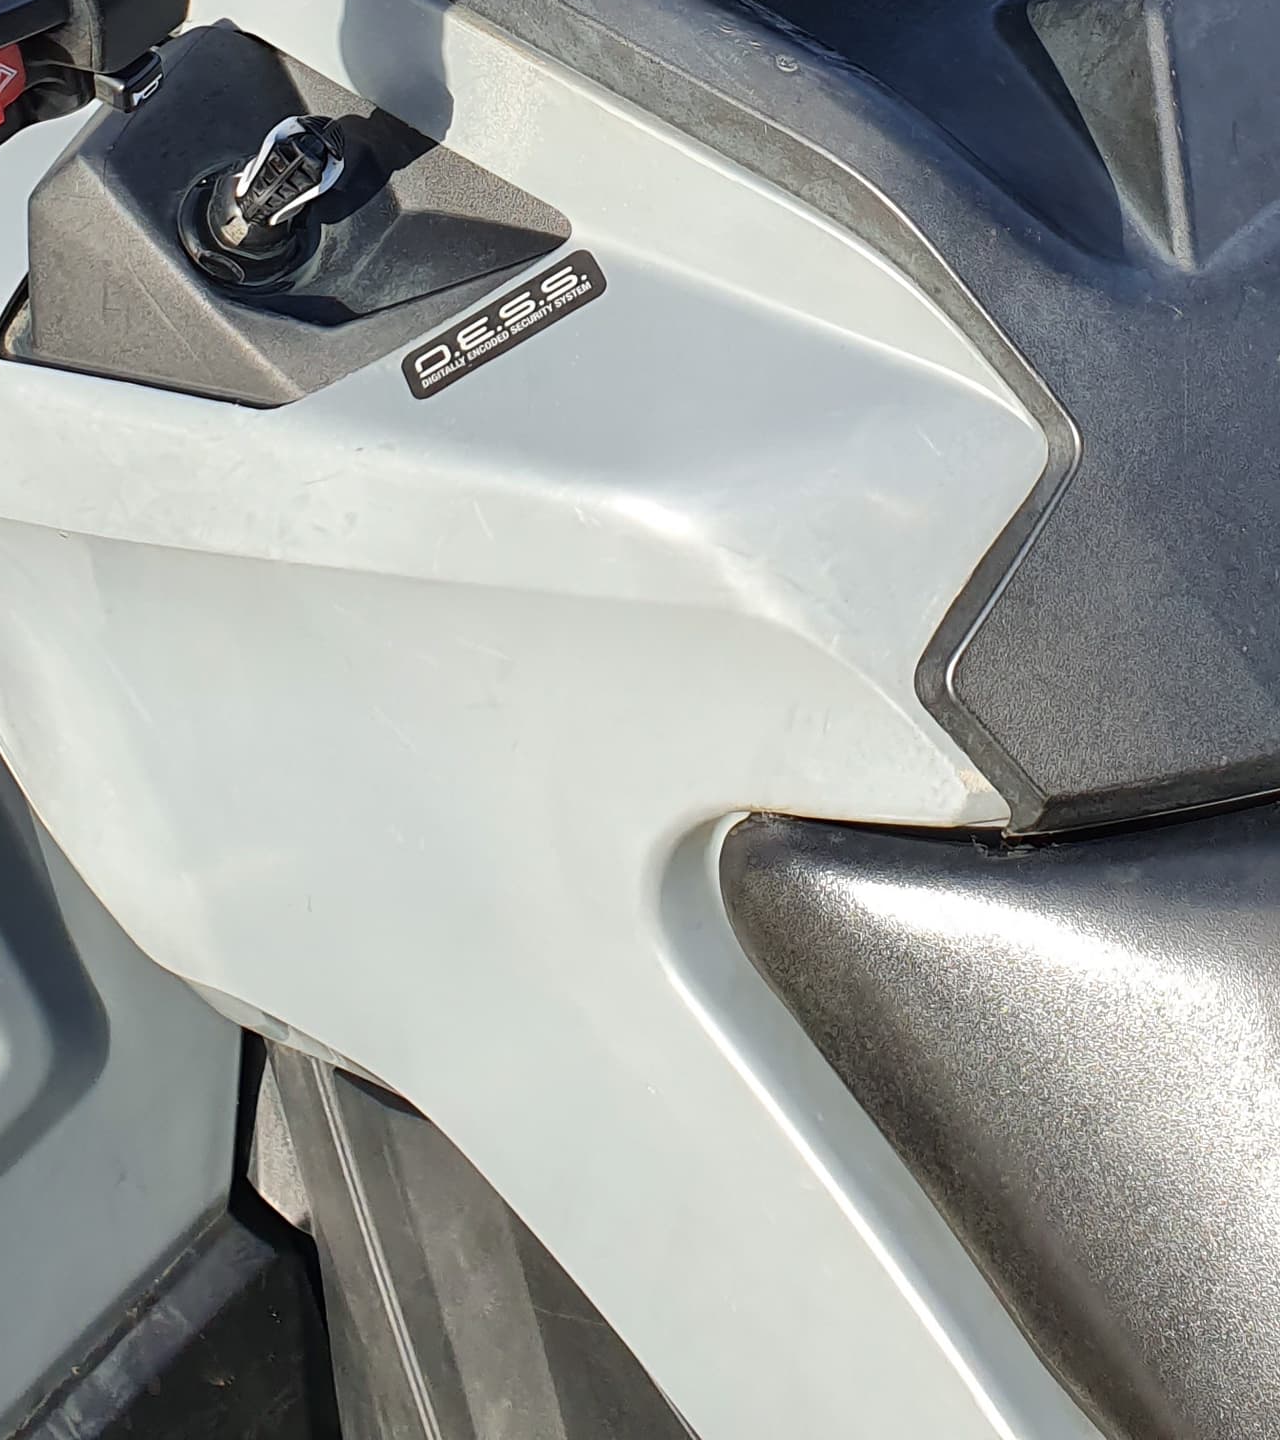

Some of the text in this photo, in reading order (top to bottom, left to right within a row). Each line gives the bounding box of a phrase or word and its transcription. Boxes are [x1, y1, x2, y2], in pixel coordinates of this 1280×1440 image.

[421, 281, 592, 389] DIGITALLY ENCODED SECURITY SYSTEM
